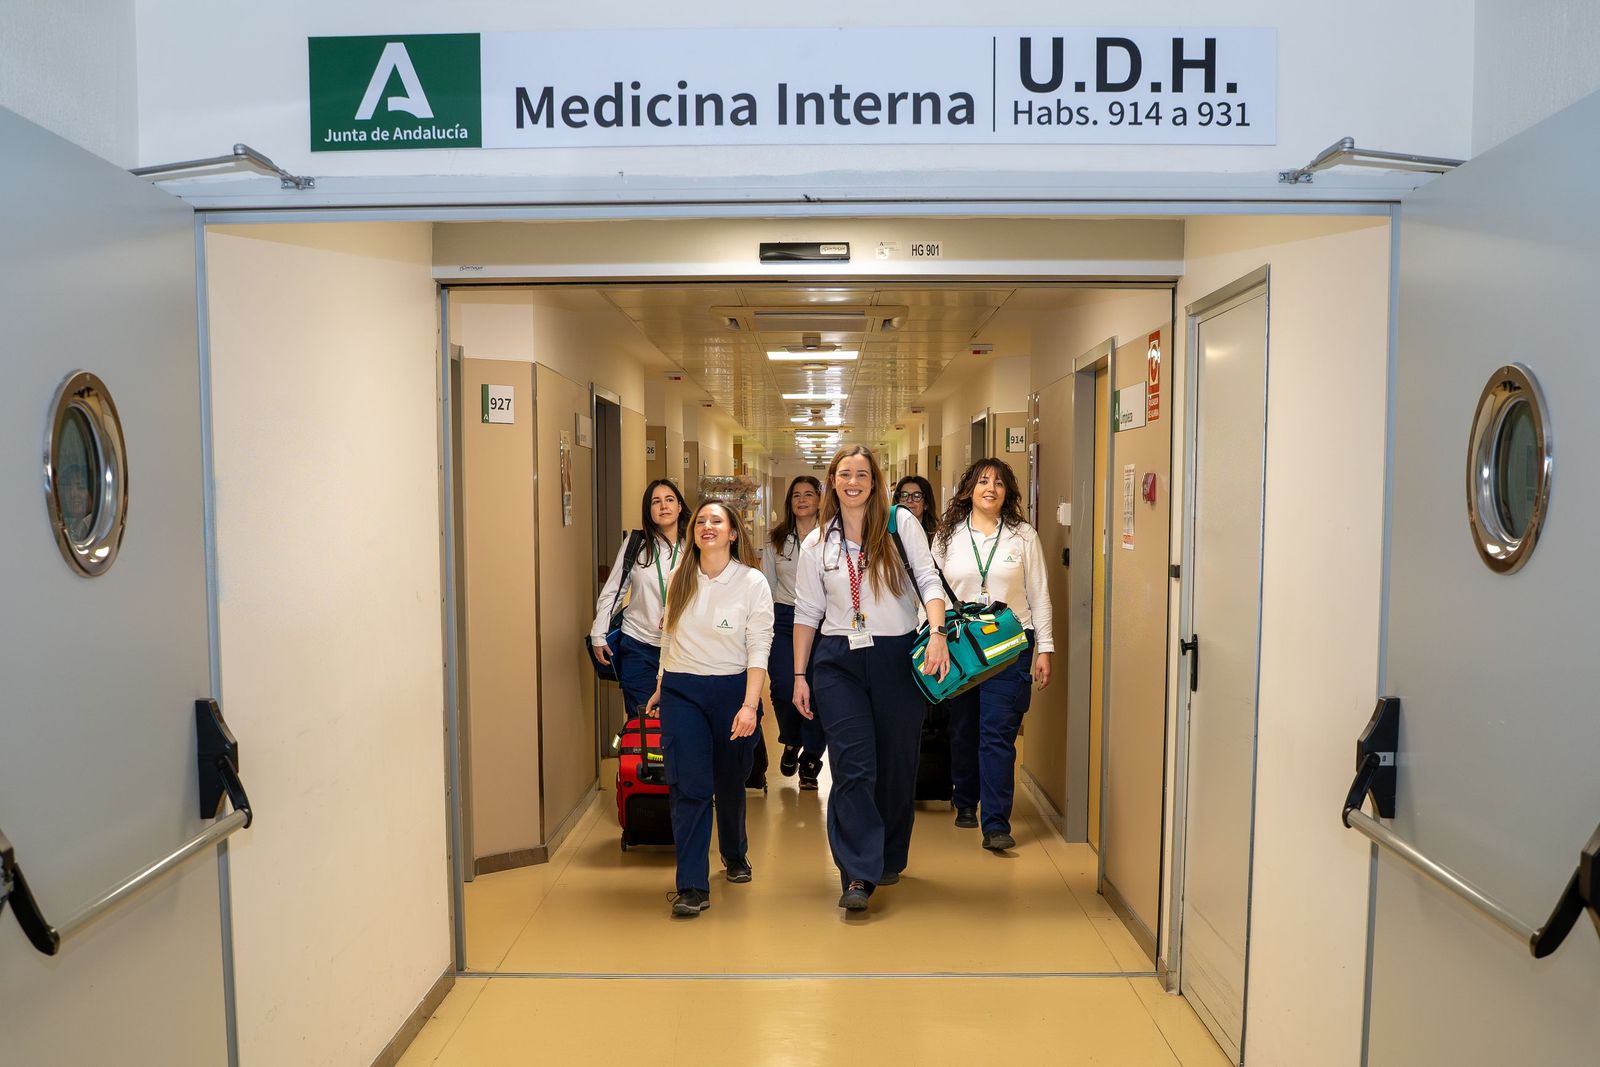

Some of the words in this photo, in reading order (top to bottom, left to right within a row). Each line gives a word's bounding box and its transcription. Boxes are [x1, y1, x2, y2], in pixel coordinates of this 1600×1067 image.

[1018, 36, 1239, 95] U.D.H.
[514, 79, 758, 129] Medicina
[778, 82, 976, 126] Interna
[1012, 99, 1098, 127] Habs.
[1107, 100, 1163, 127] 914
[1171, 107, 1188, 127] a
[1197, 101, 1251, 128] 931
[323, 128, 368, 143] Junta
[370, 126, 390, 142] de
[392, 123, 469, 142] Andalucía
[911, 244, 924, 257] HG
[926, 244, 940, 257] 901
[490, 397, 512, 411] 927
[1010, 435, 1024, 444] 914
[646, 446, 655, 454] 26
